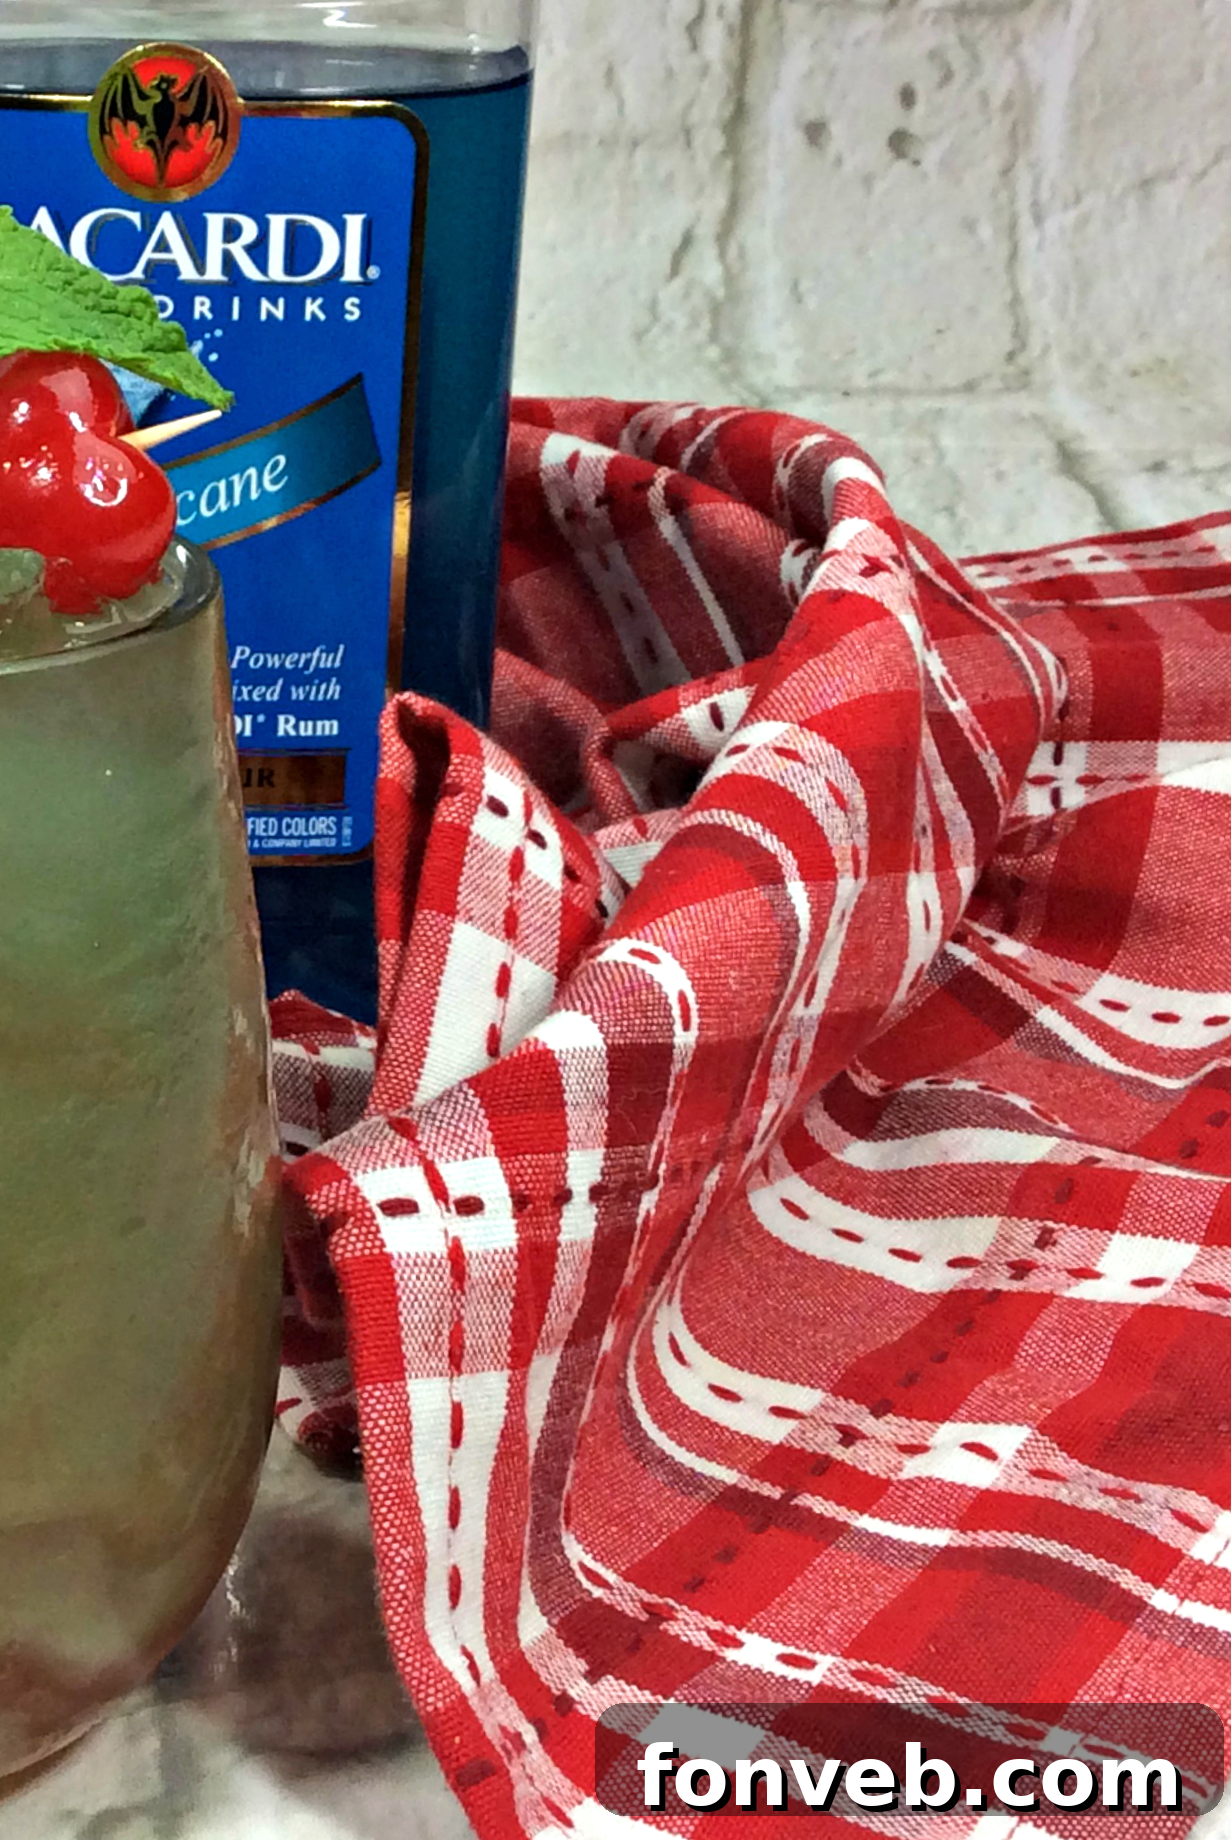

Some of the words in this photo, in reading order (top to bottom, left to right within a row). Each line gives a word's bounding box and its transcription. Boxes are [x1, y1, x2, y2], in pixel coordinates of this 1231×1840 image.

[230, 643, 345, 675] Powerful
[232, 677, 284, 702] ixed
[290, 677, 341, 701] with
[276, 714, 339, 738] Rum
[281, 815, 337, 837] COLORS
